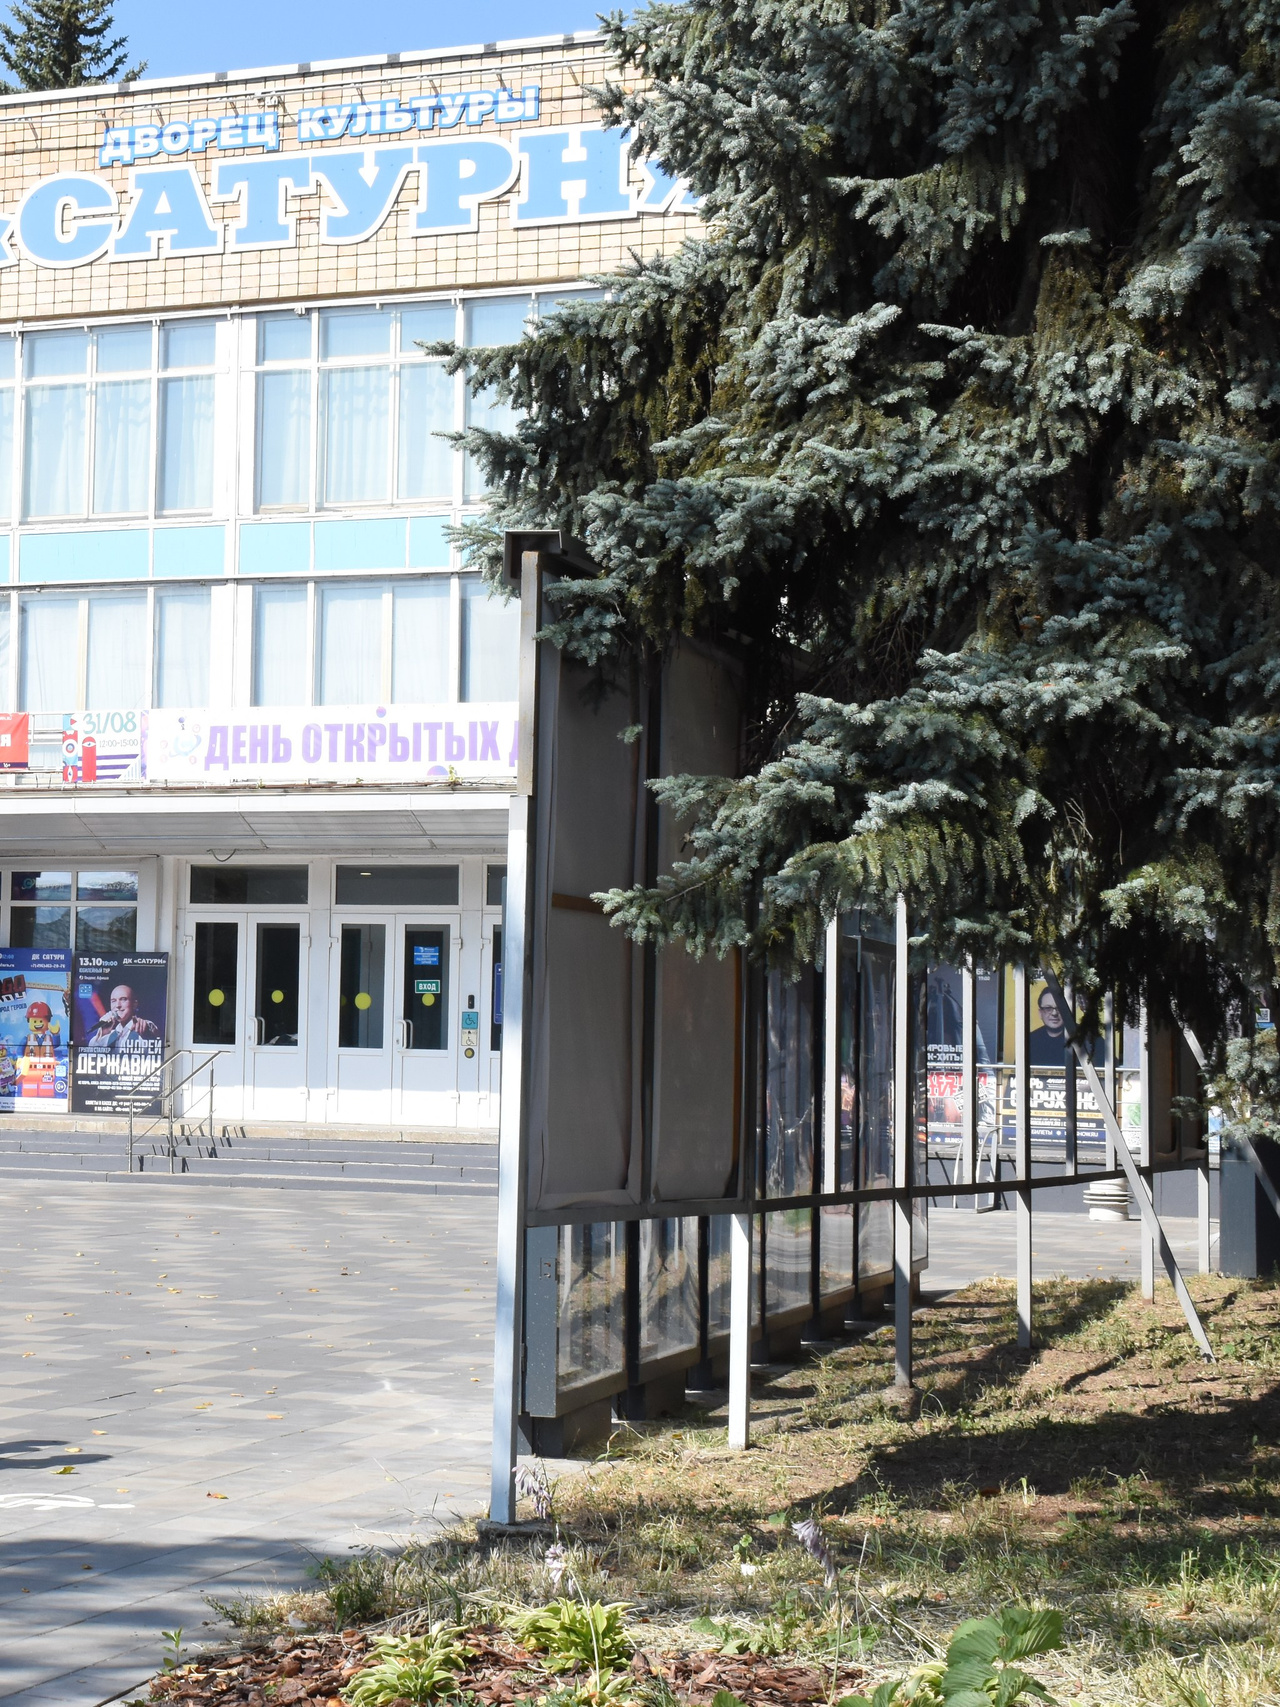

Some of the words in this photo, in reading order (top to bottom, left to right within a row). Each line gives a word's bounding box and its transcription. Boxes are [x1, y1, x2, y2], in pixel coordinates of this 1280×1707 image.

[99, 112, 280, 166] ДВОРЕЦ
[297, 85, 540, 143] КУЛЬТУРЫ
[83, 711, 137, 734] 31/08
[99, 739, 138, 748] 12:00-15:00
[204, 724, 292, 771] ДЕНЬ
[301, 721, 501, 764] ОТКРЫТЫХ
[79, 957, 102, 966] 13.10
[418, 983, 437, 991] ВХОД
[119, 1037, 162, 1054] АНДРЕЙ
[76, 1053, 161, 1076] ДЕРЖАВИН
